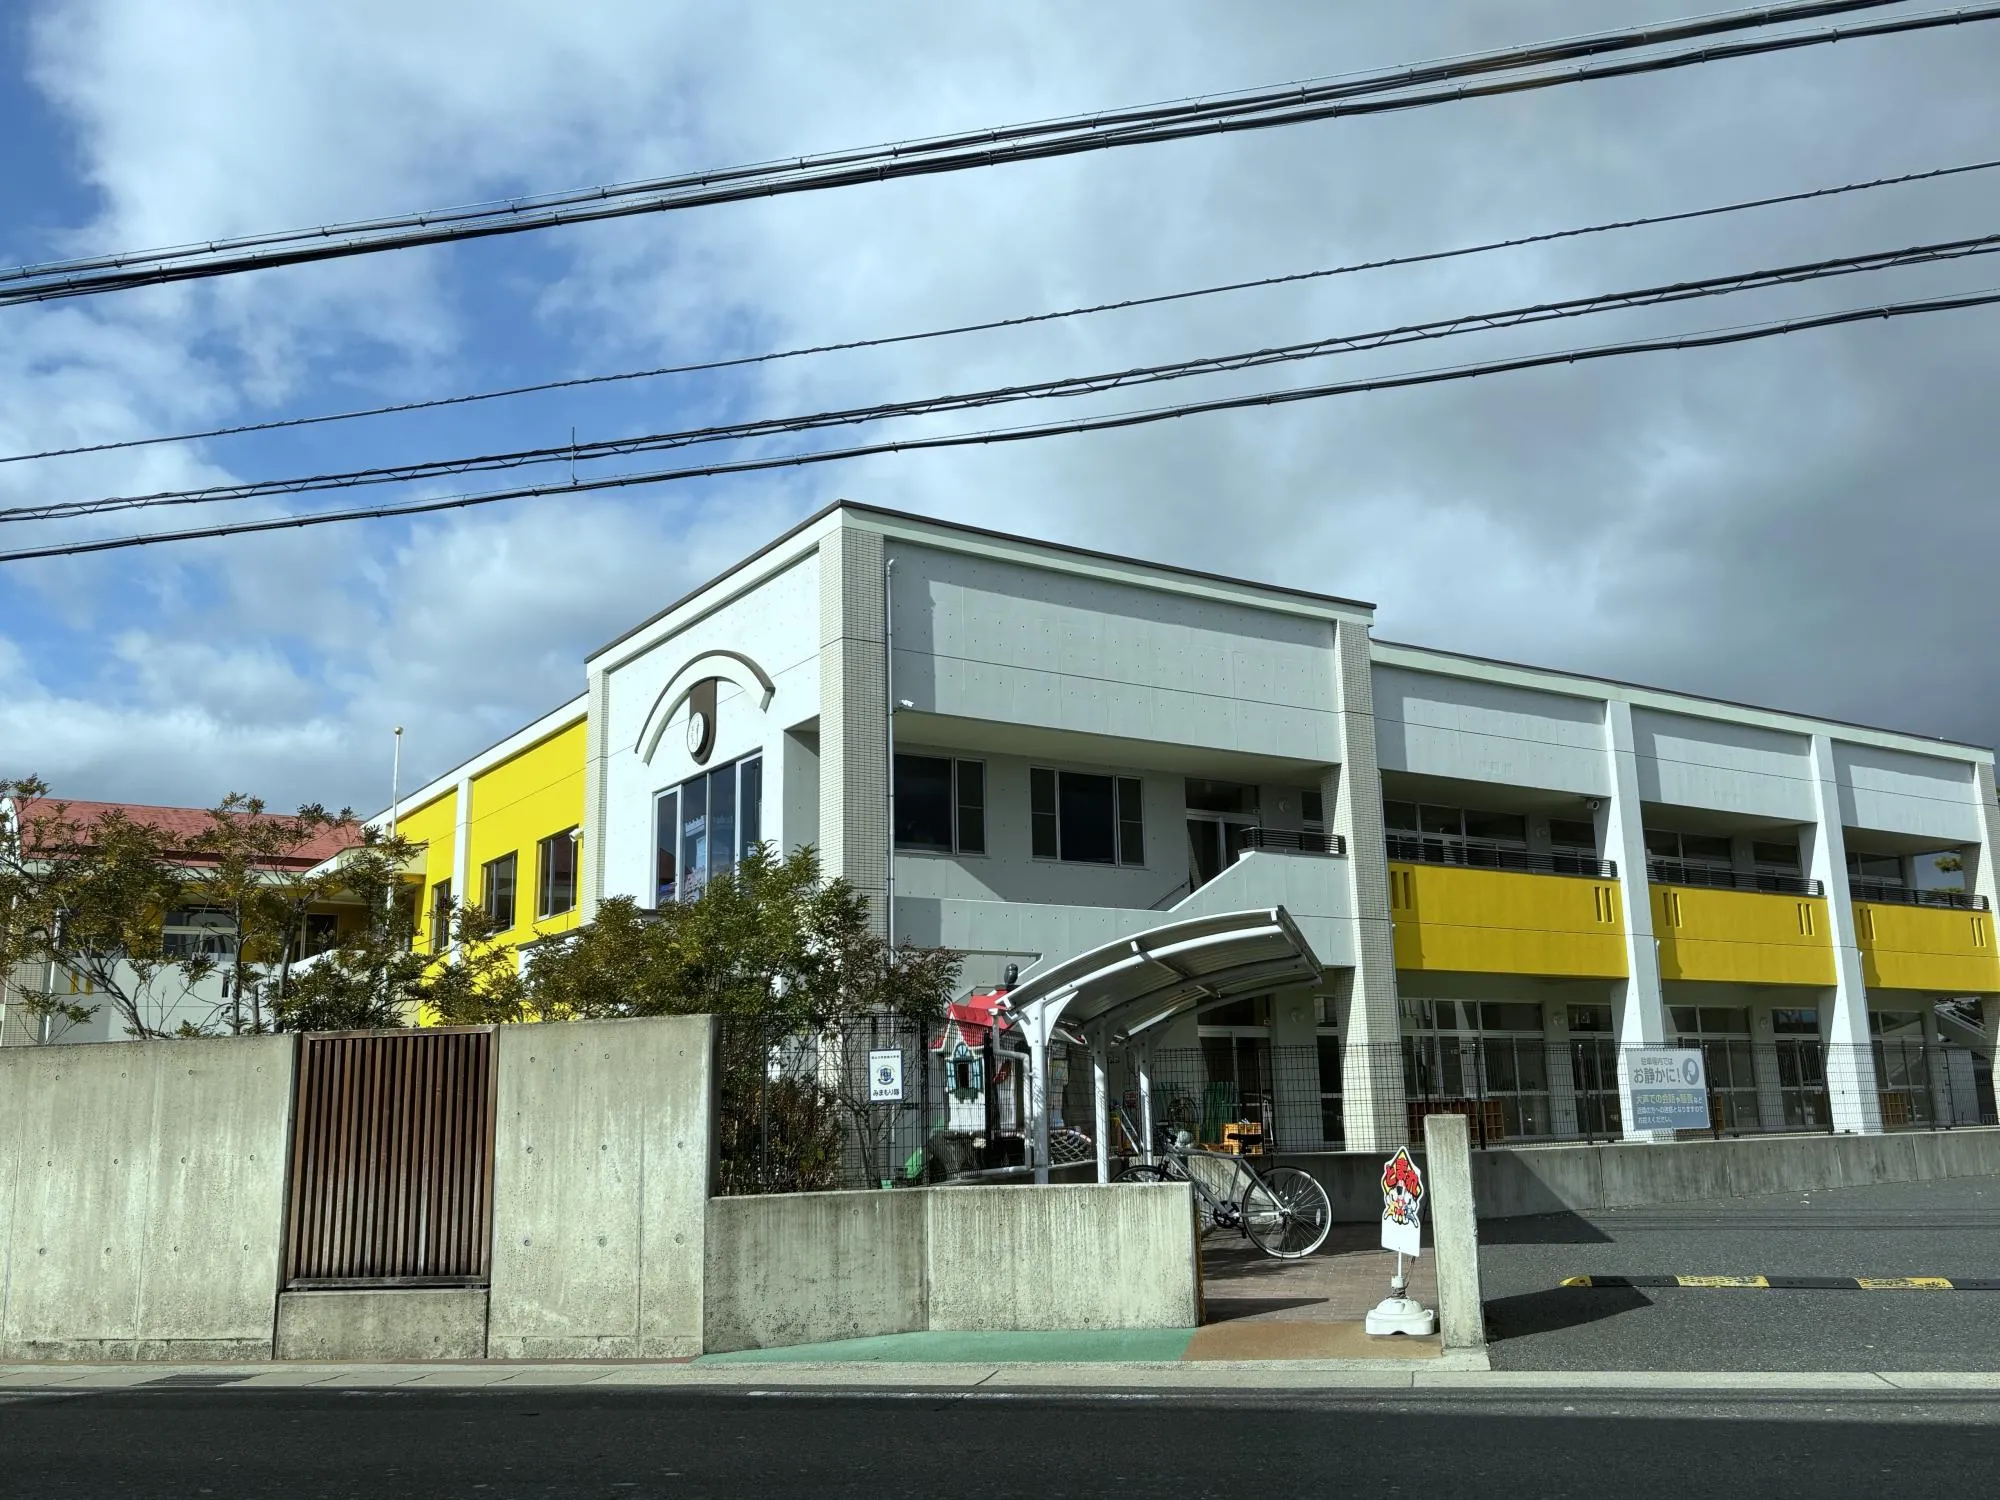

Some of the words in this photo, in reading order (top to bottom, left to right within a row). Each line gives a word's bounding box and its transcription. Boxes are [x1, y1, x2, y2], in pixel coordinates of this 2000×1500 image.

[1640, 1057, 1674, 1066] 駐車場内では
[872, 1088, 900, 1097] みまもり隊
[1386, 1157, 1419, 1198] とまれ
